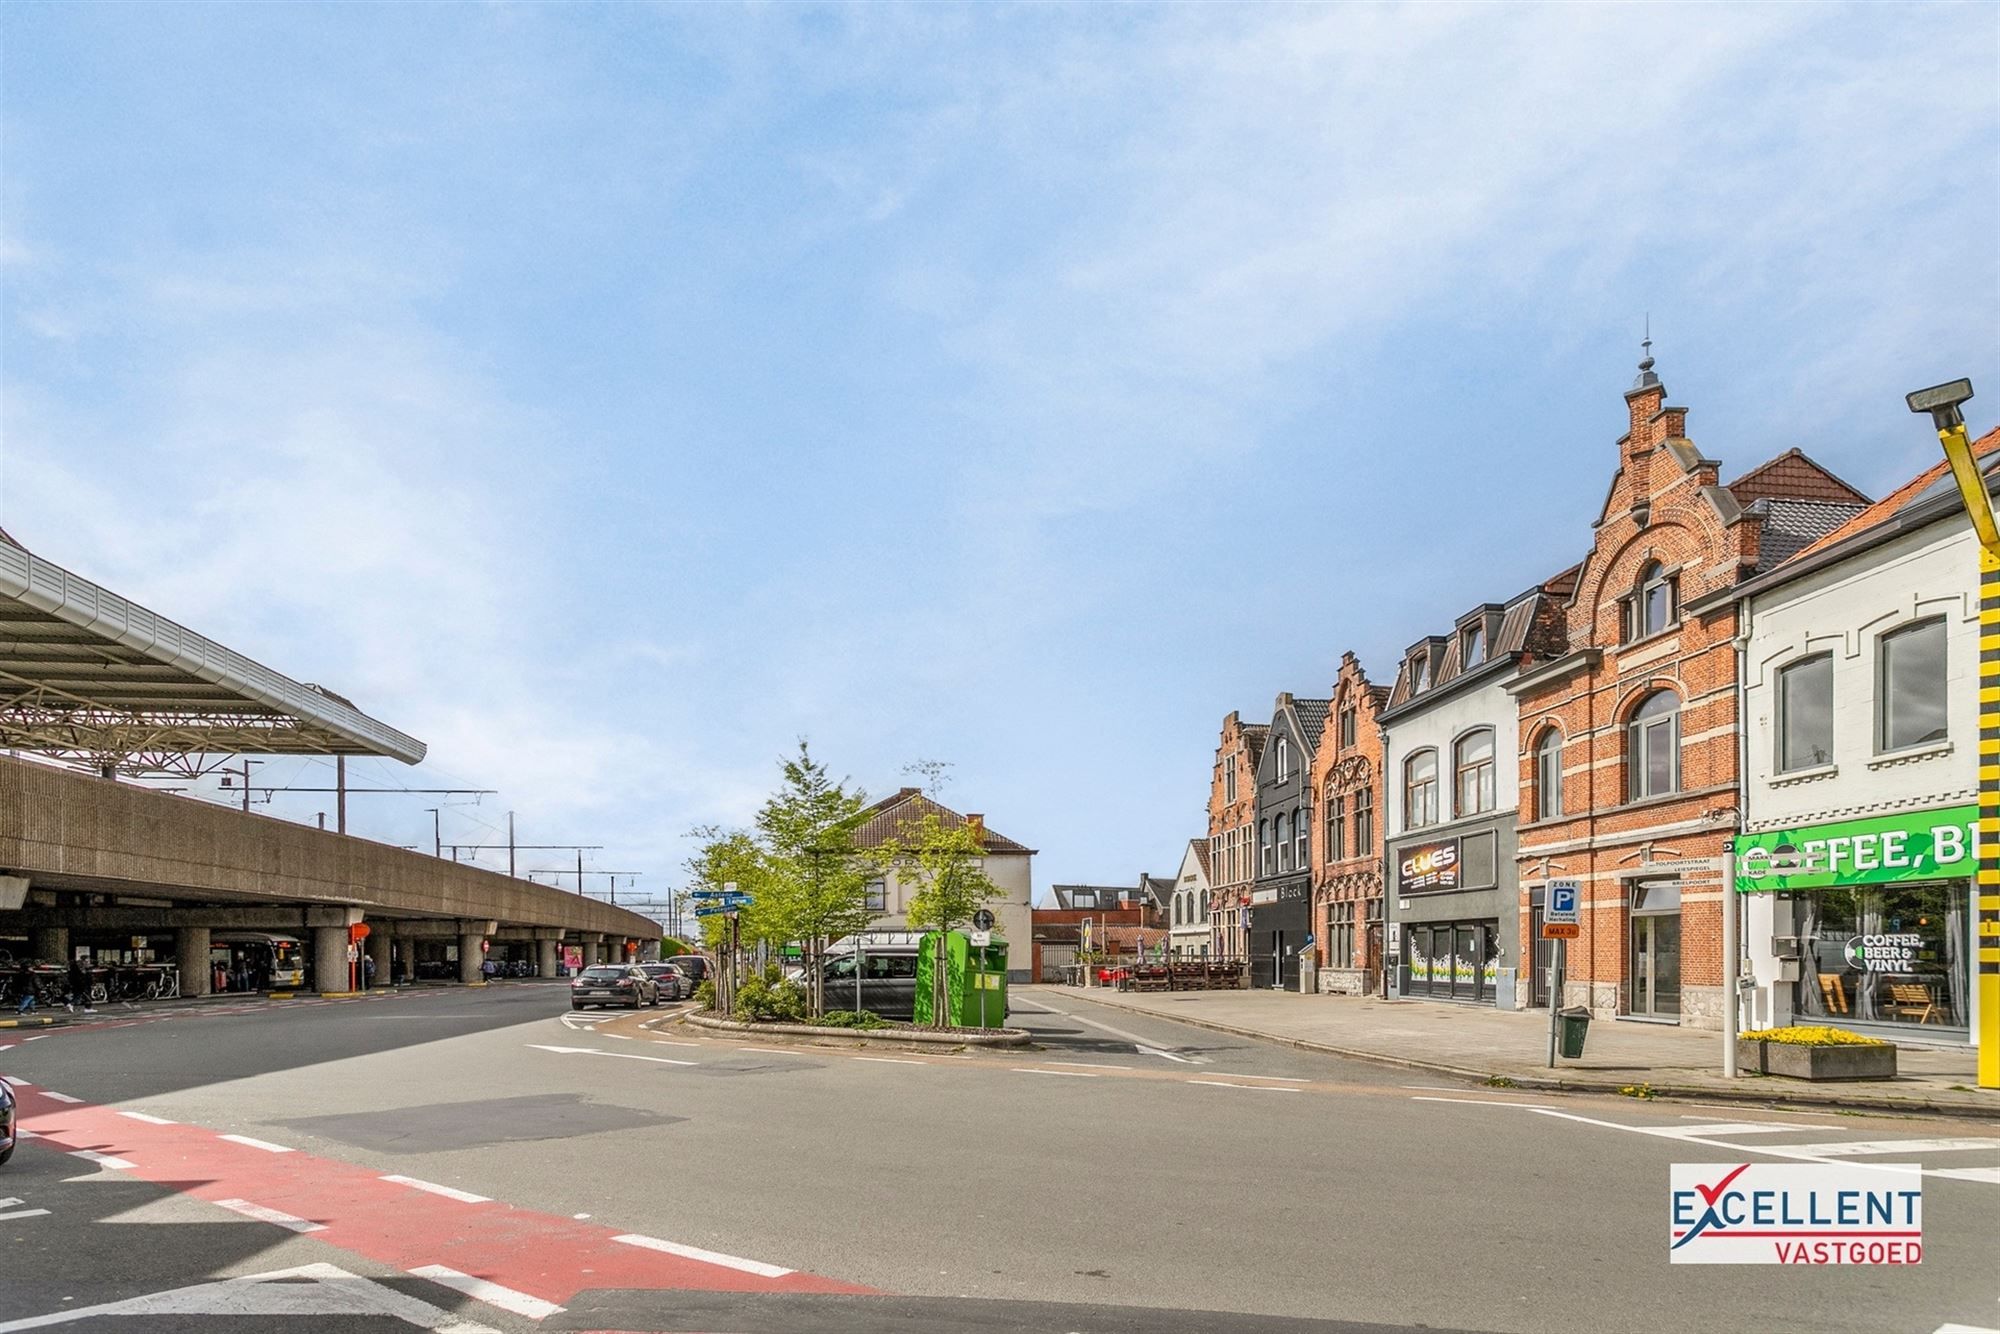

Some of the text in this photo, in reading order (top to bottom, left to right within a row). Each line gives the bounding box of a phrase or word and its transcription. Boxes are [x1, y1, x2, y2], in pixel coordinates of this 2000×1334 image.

[1401, 845, 1456, 877] CLUES
[1656, 859, 1710, 867] TOLPOORTSTRAAT
[1556, 890, 1571, 909] P
[1549, 927, 1565, 935] MAX
[1863, 934, 1925, 948] COFFEE,
[1864, 947, 1912, 959] BEER &
[1864, 959, 1913, 972] VINYL
